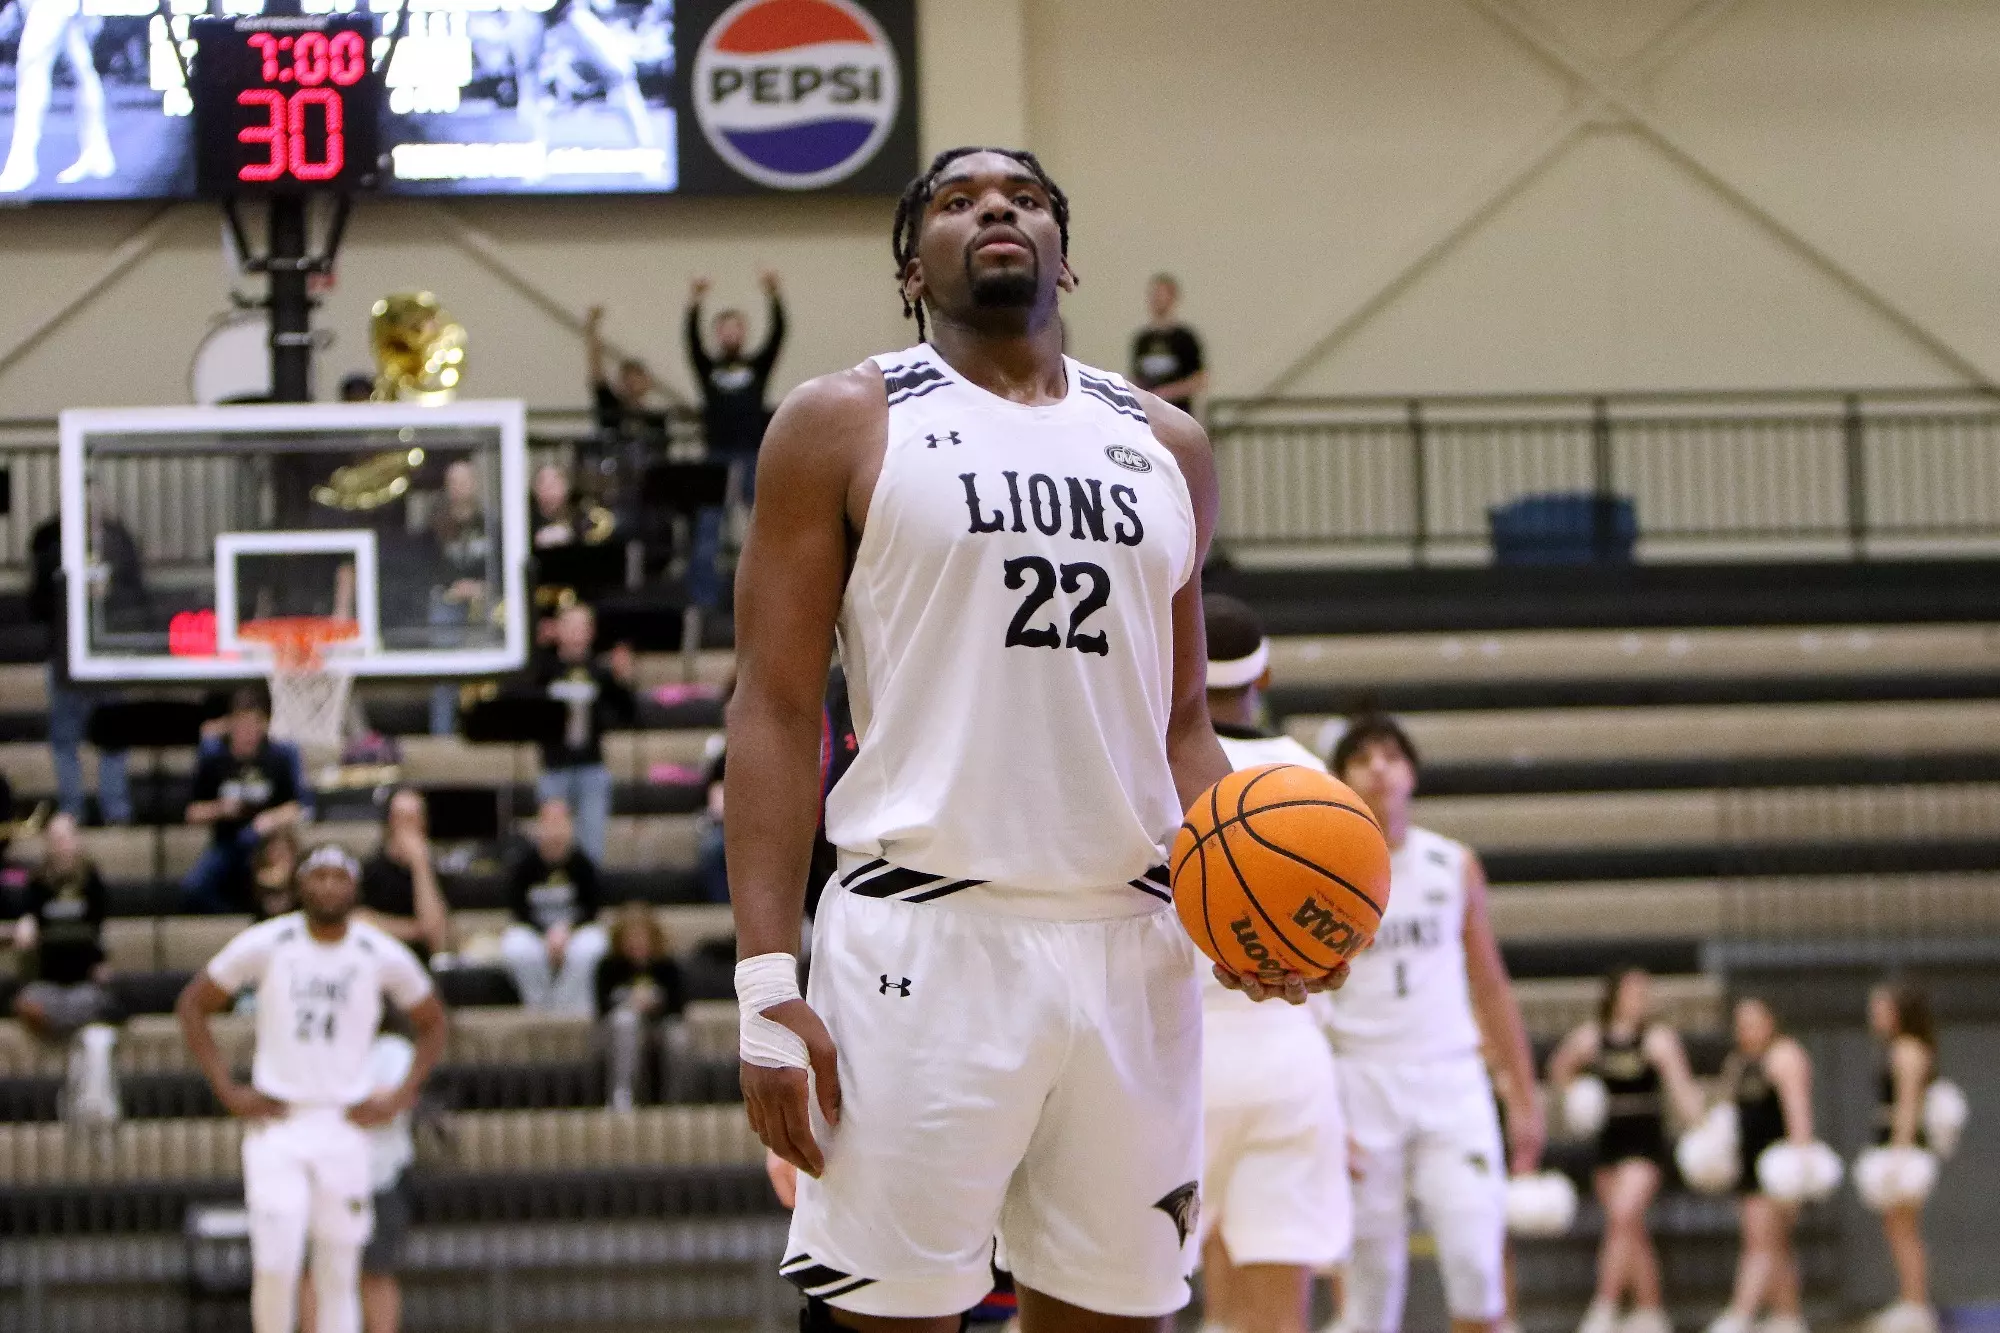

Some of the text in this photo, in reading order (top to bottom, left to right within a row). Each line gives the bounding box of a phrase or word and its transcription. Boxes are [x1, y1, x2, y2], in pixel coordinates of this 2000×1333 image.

[247, 30, 366, 86] 7:00
[711, 65, 881, 104] PEPSI
[237, 87, 344, 181] 30
[958, 470, 1145, 546] LIONS
[1003, 555, 1111, 657] 22
[1292, 895, 1365, 959] NCAA
